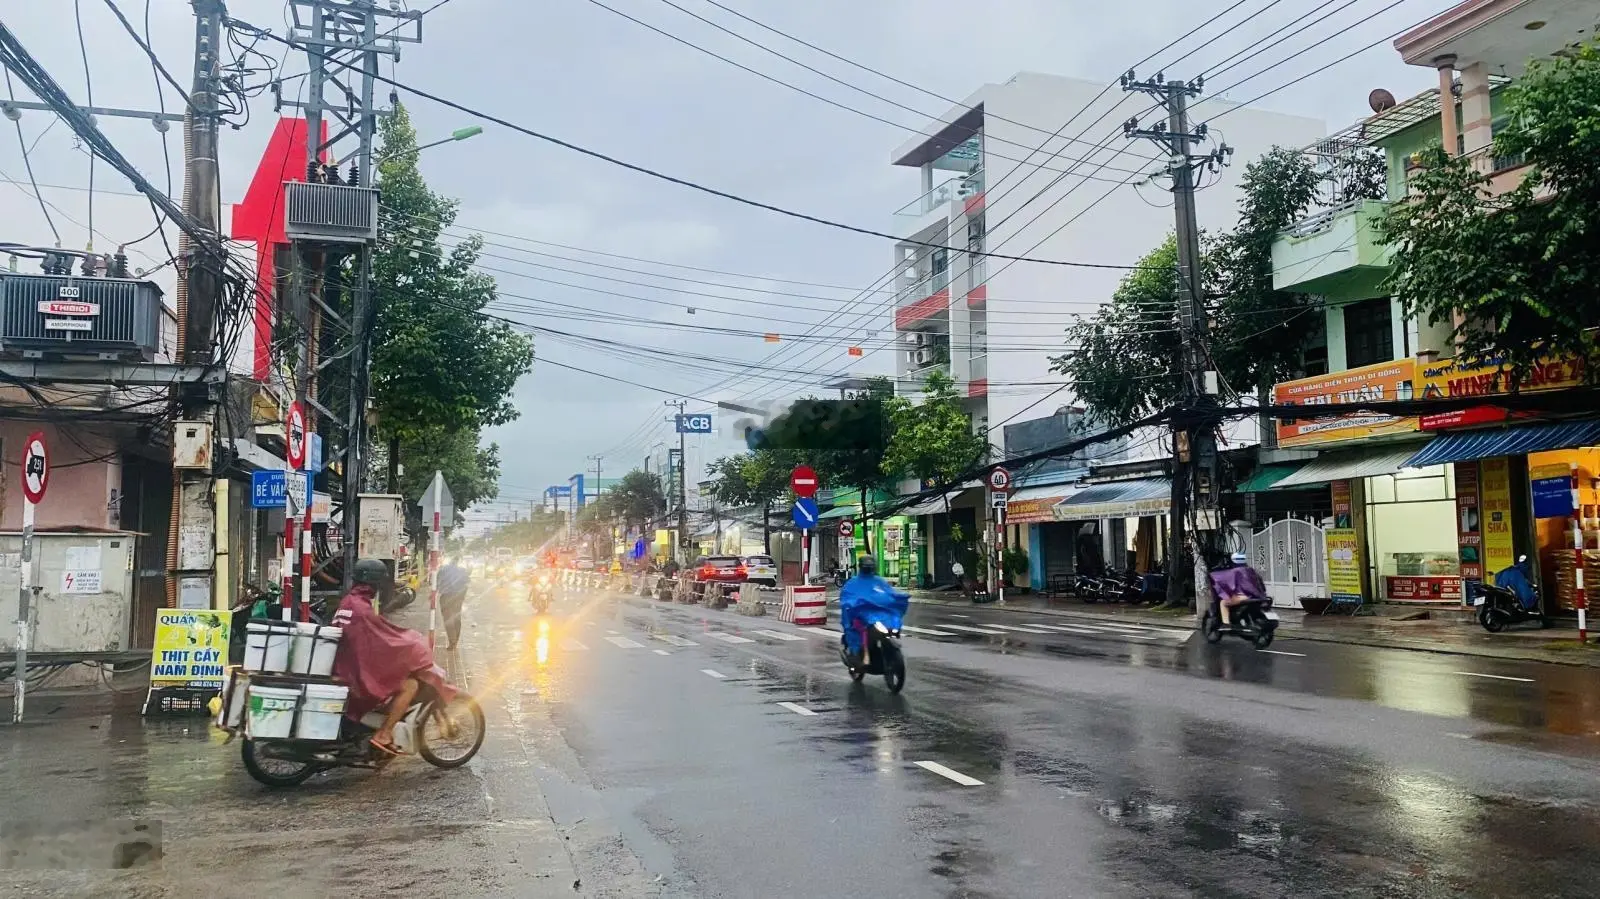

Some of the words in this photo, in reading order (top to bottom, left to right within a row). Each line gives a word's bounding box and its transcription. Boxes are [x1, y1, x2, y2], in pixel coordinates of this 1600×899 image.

[61, 288, 79, 296] 400
[679, 417, 710, 430] ACB
[994, 474, 1004, 485] 40
[1459, 535, 1480, 544] LAPTOP
[1464, 568, 1478, 576] IPAD
[161, 650, 190, 664] THỊT
[154, 664, 187, 676] NAM
[191, 665, 224, 679] ĐỊNH
